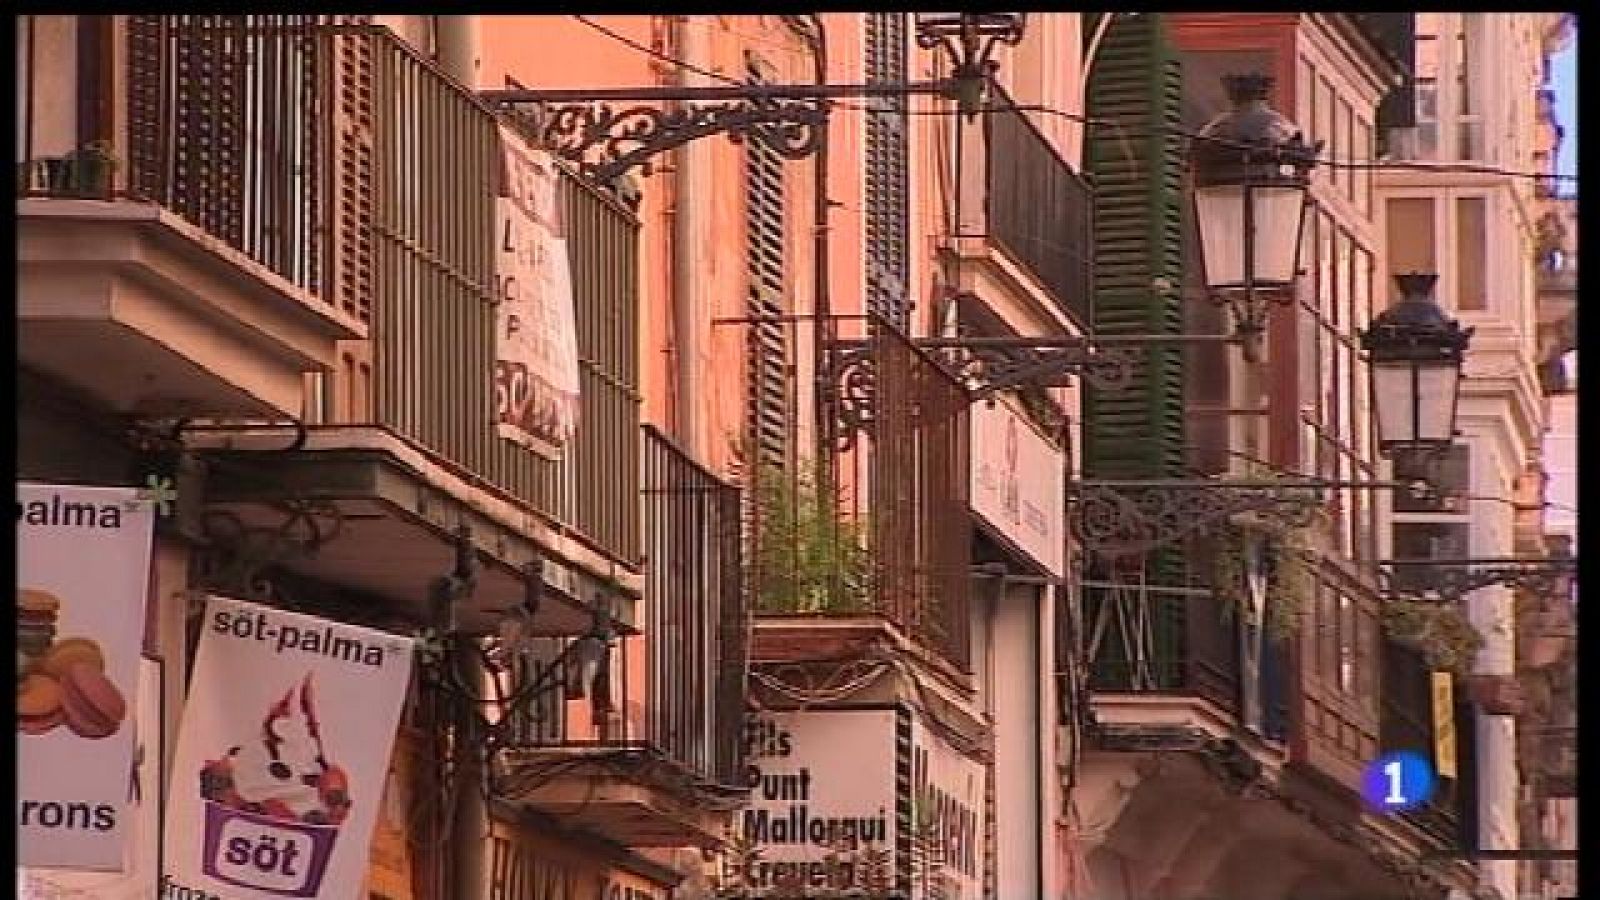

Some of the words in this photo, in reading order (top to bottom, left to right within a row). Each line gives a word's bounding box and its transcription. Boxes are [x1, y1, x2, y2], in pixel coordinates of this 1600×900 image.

[17, 494, 121, 528] alma
[213, 610, 383, 666] söt-palma
[20, 800, 116, 830] rons
[225, 834, 299, 876] söt
